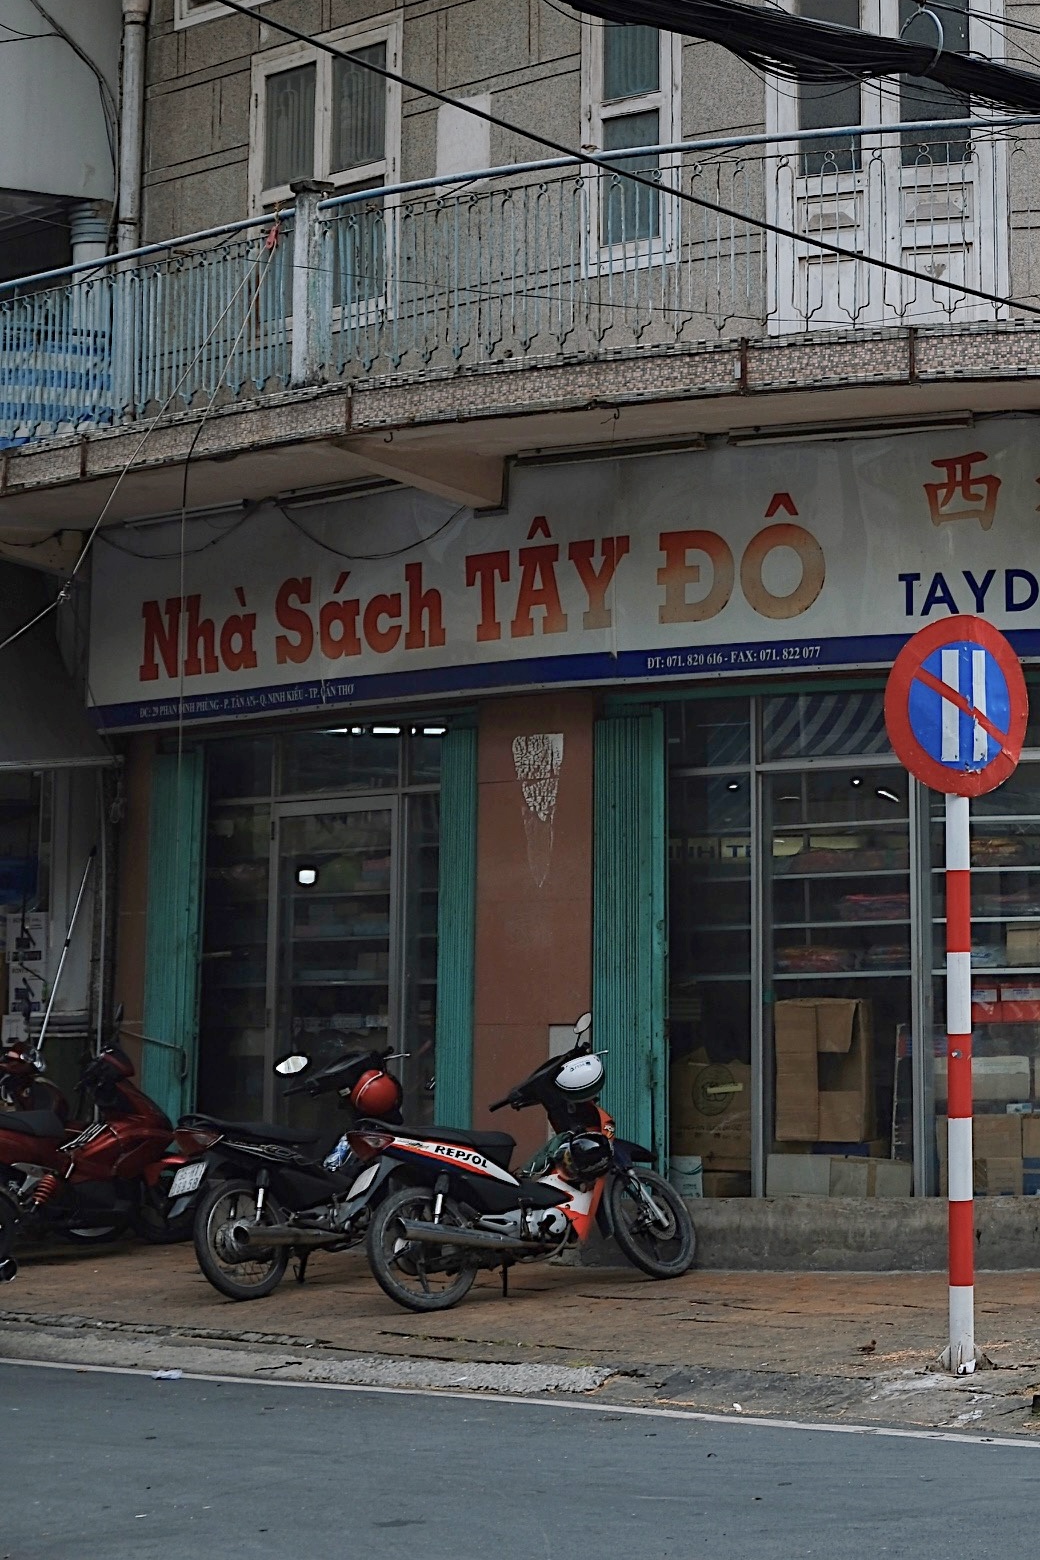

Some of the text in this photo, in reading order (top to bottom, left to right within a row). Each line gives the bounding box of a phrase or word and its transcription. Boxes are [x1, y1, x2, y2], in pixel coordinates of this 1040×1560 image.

[138, 492, 827, 682] Nhà Sách TÂY ĐÔ
[687, 653, 704, 666] 820
[706, 652, 723, 665] 616
[730, 650, 757, 664] FAX:
[782, 647, 800, 660] 822
[802, 645, 821, 659] 077
[434, 1145, 488, 1169] REPSOL
